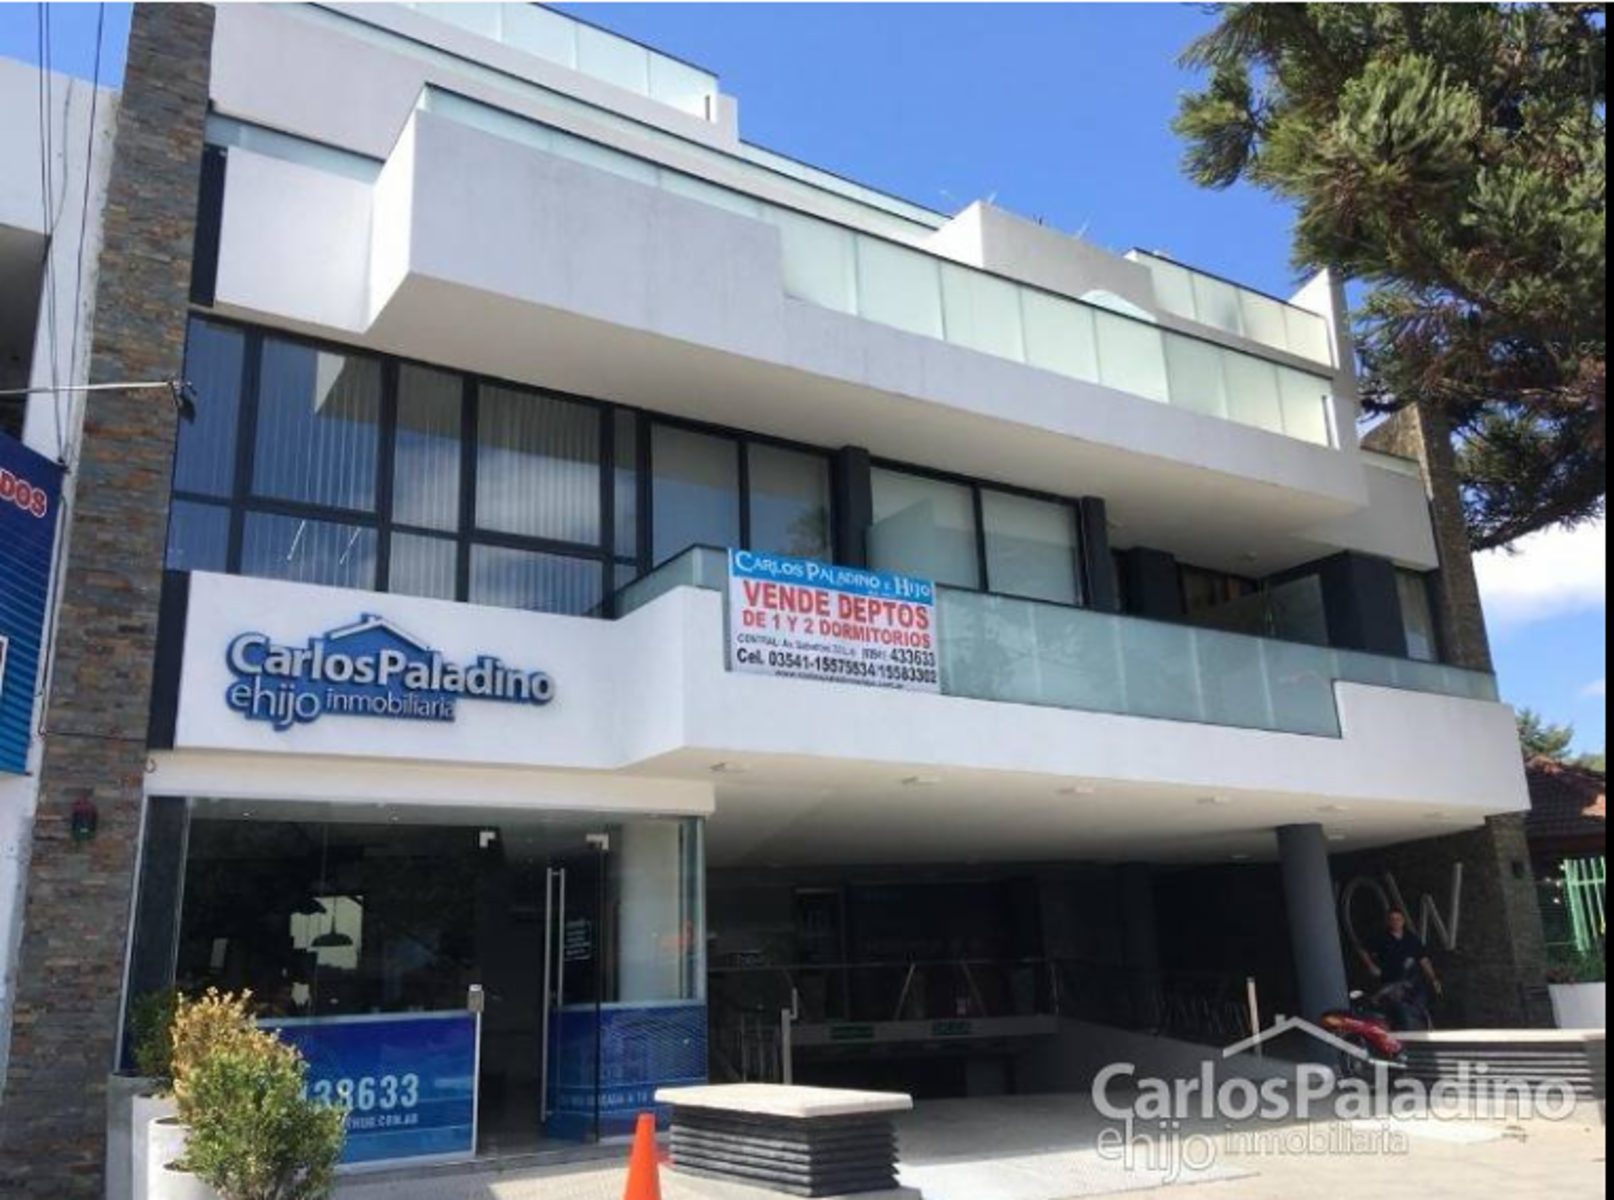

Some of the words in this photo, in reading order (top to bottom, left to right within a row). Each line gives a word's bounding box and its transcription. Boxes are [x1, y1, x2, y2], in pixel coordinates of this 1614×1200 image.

[735, 551, 803, 577] CARLOS
[806, 562, 880, 589] PALADINO
[743, 580, 830, 617] VENDE
[838, 593, 930, 630] DEPTOS
[742, 610, 767, 628] DE
[773, 614, 780, 631] 1
[786, 616, 798, 632] Y
[804, 618, 814, 635] 2
[819, 619, 931, 649] DORMITORIOS
